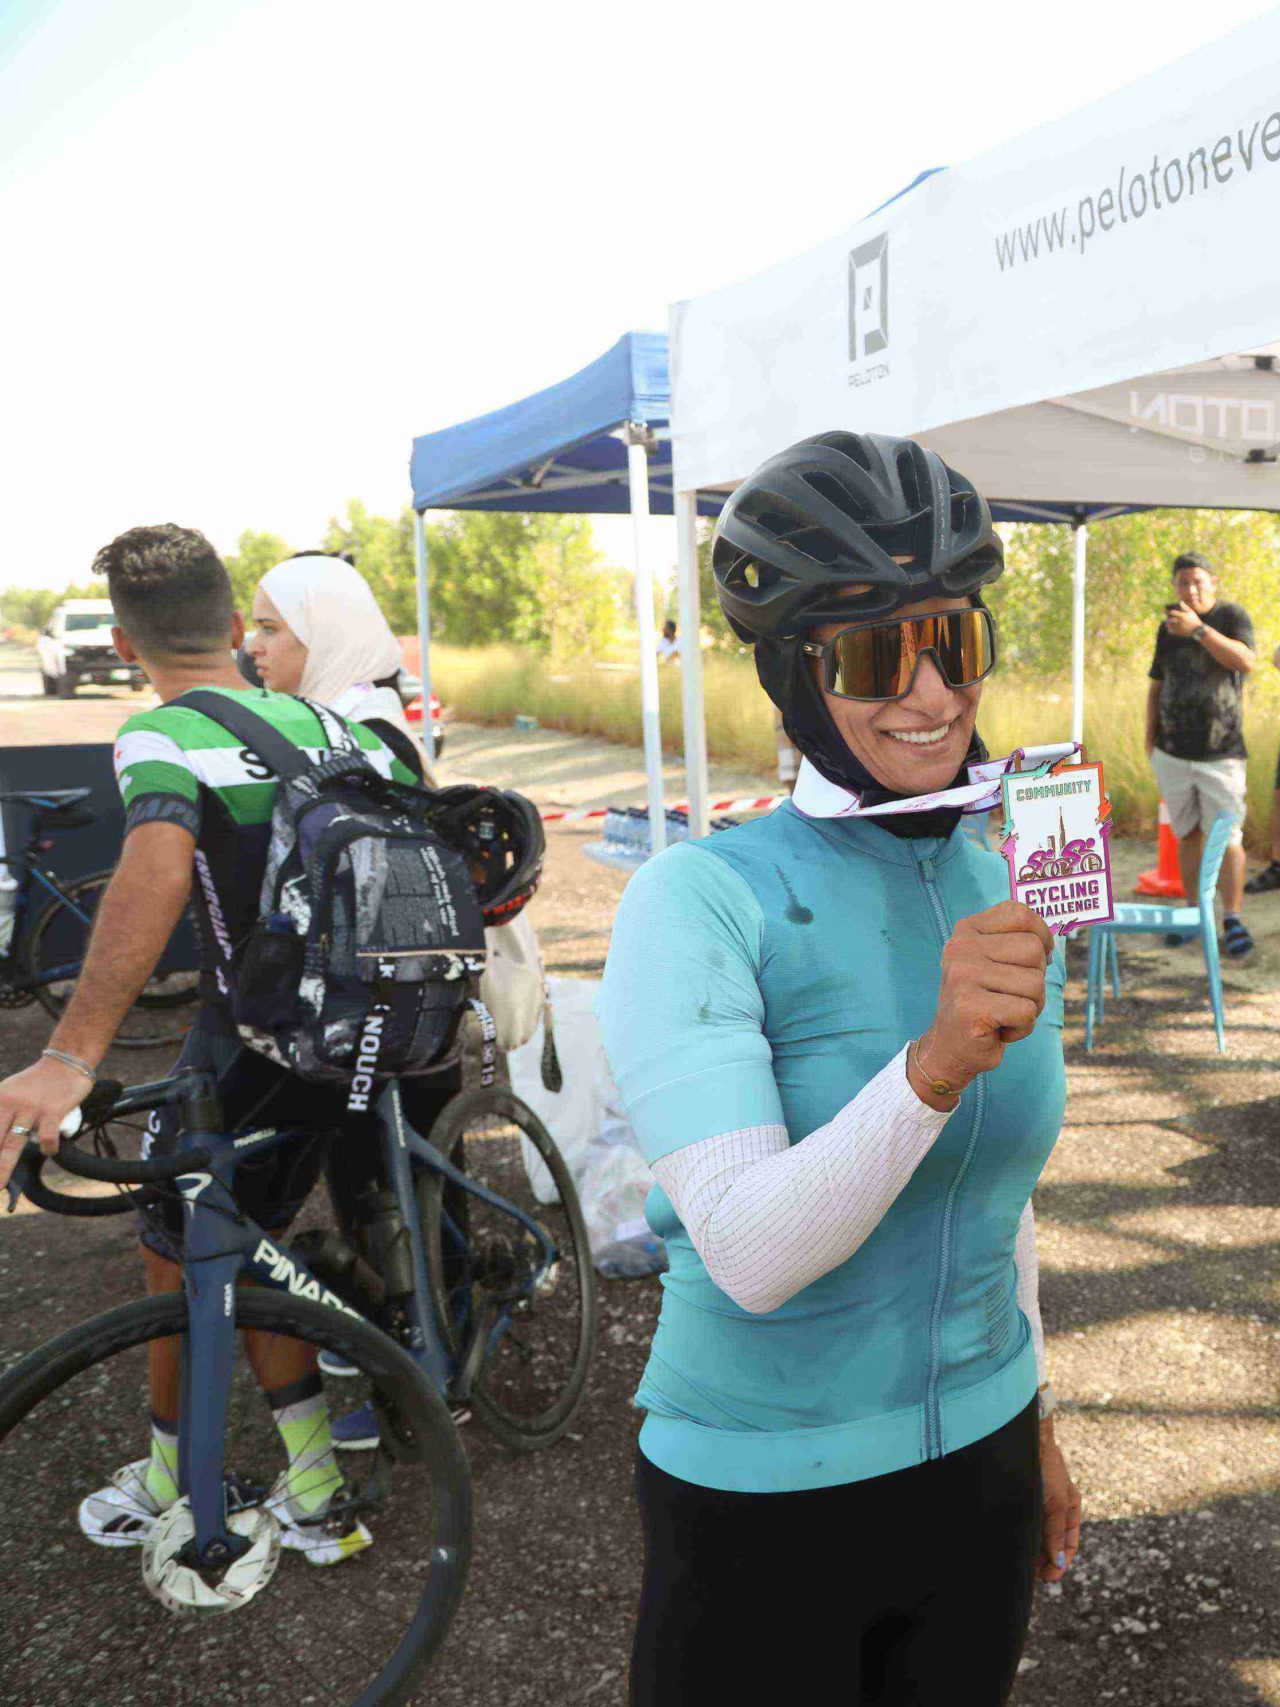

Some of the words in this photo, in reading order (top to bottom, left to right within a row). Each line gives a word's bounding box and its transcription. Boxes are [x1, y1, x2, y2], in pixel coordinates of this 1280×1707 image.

[1016, 779, 1091, 801] COMMUNITY
[1025, 878, 1100, 907] CYCLING
[253, 1238, 365, 1322] PINA
